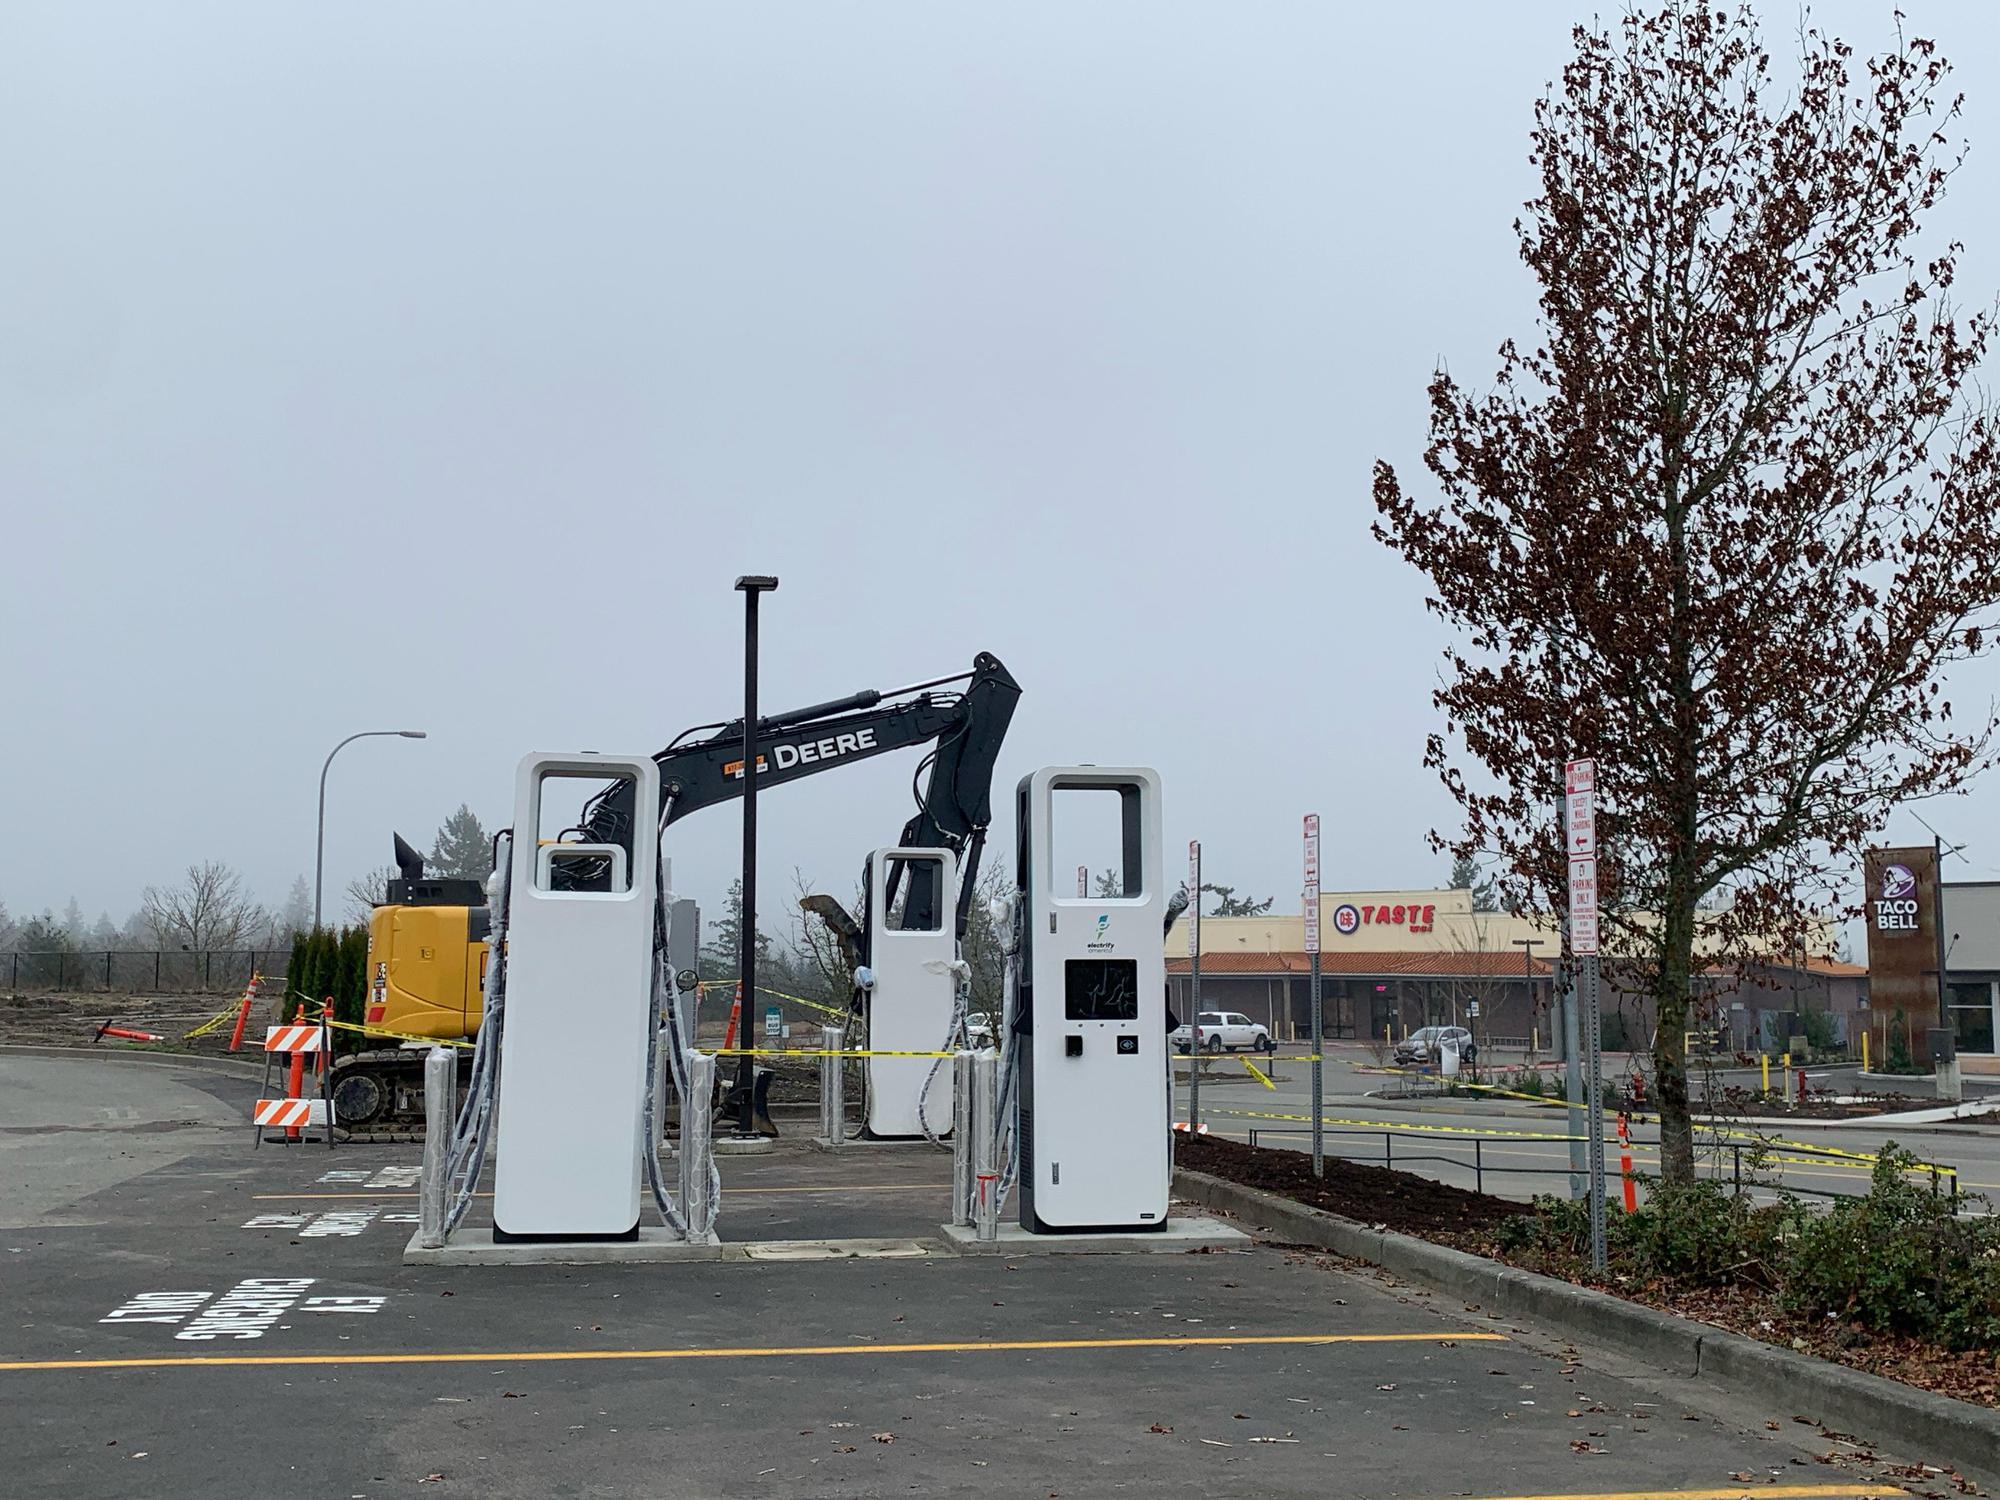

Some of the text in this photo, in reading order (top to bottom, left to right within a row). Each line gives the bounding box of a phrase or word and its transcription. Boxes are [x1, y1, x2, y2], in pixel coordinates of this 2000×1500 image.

[774, 728, 877, 769] DEERE
[1572, 878, 1593, 891] PARKING
[1361, 904, 1435, 925] TASTE
[1874, 900, 1918, 914] TACO
[1878, 915, 1918, 930] BELL
[98, 1291, 214, 1324] ONLY
[174, 1278, 316, 1340] CHARGING
[299, 1296, 387, 1313] EV
